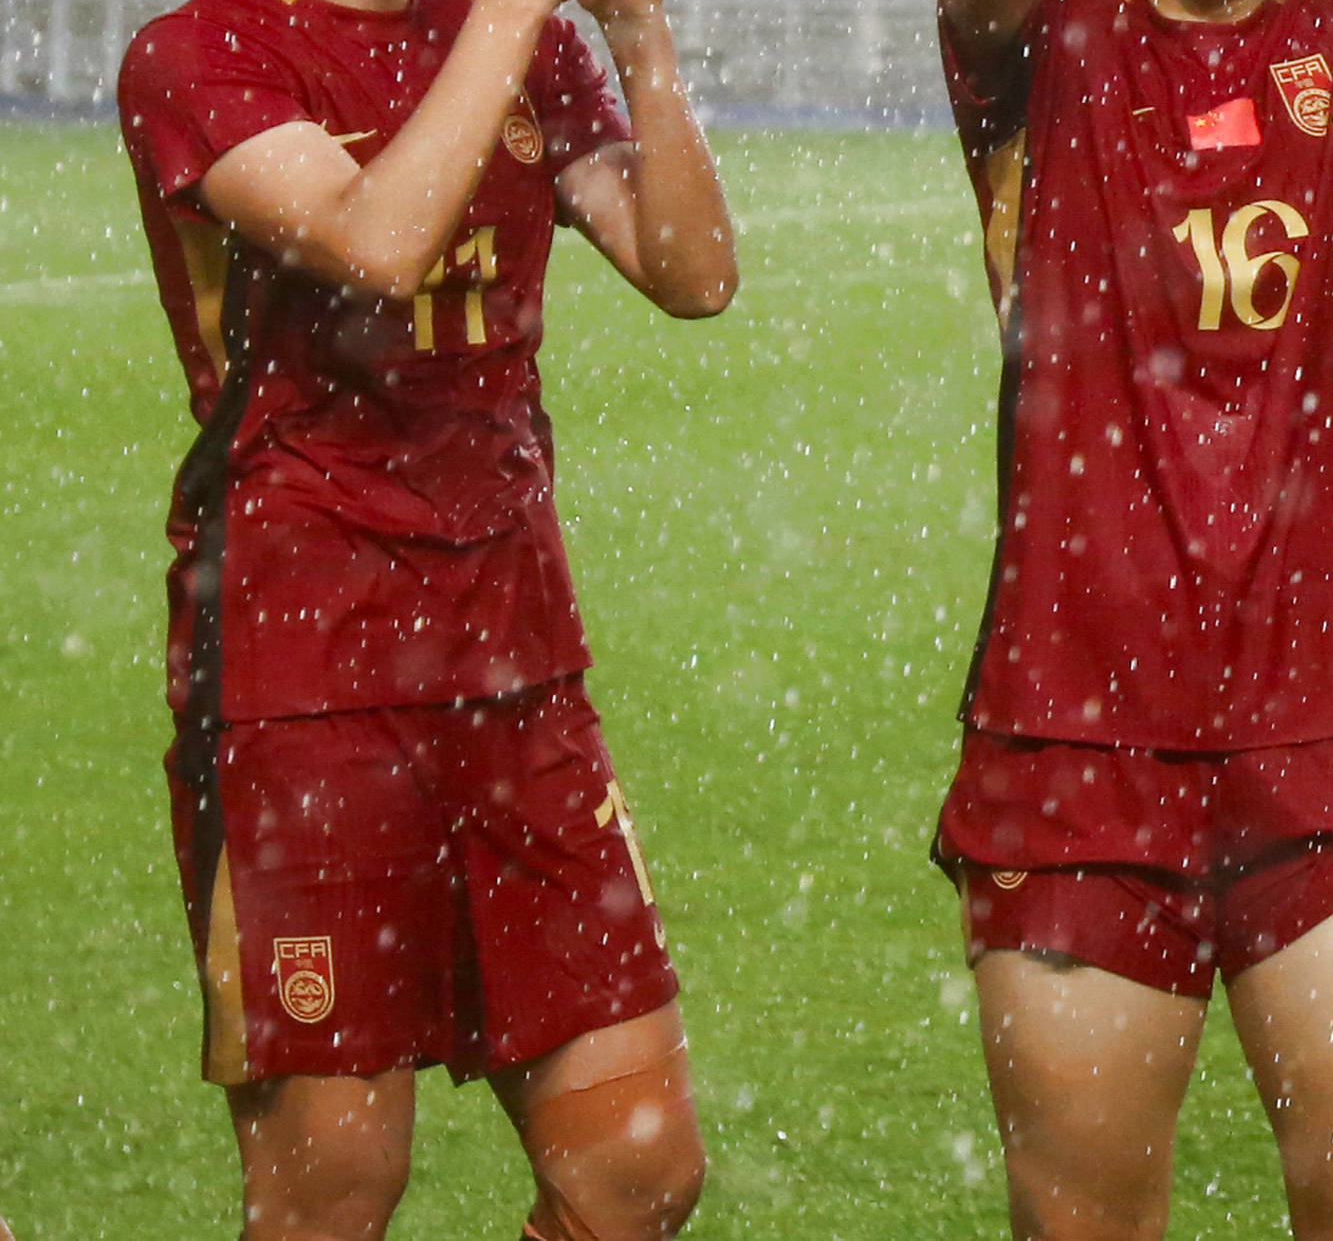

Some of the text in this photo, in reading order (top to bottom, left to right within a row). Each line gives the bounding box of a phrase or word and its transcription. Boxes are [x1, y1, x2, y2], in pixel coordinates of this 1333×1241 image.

[1276, 61, 1323, 84] CFA
[1172, 200, 1309, 330] 16
[280, 942, 327, 958] CFA
